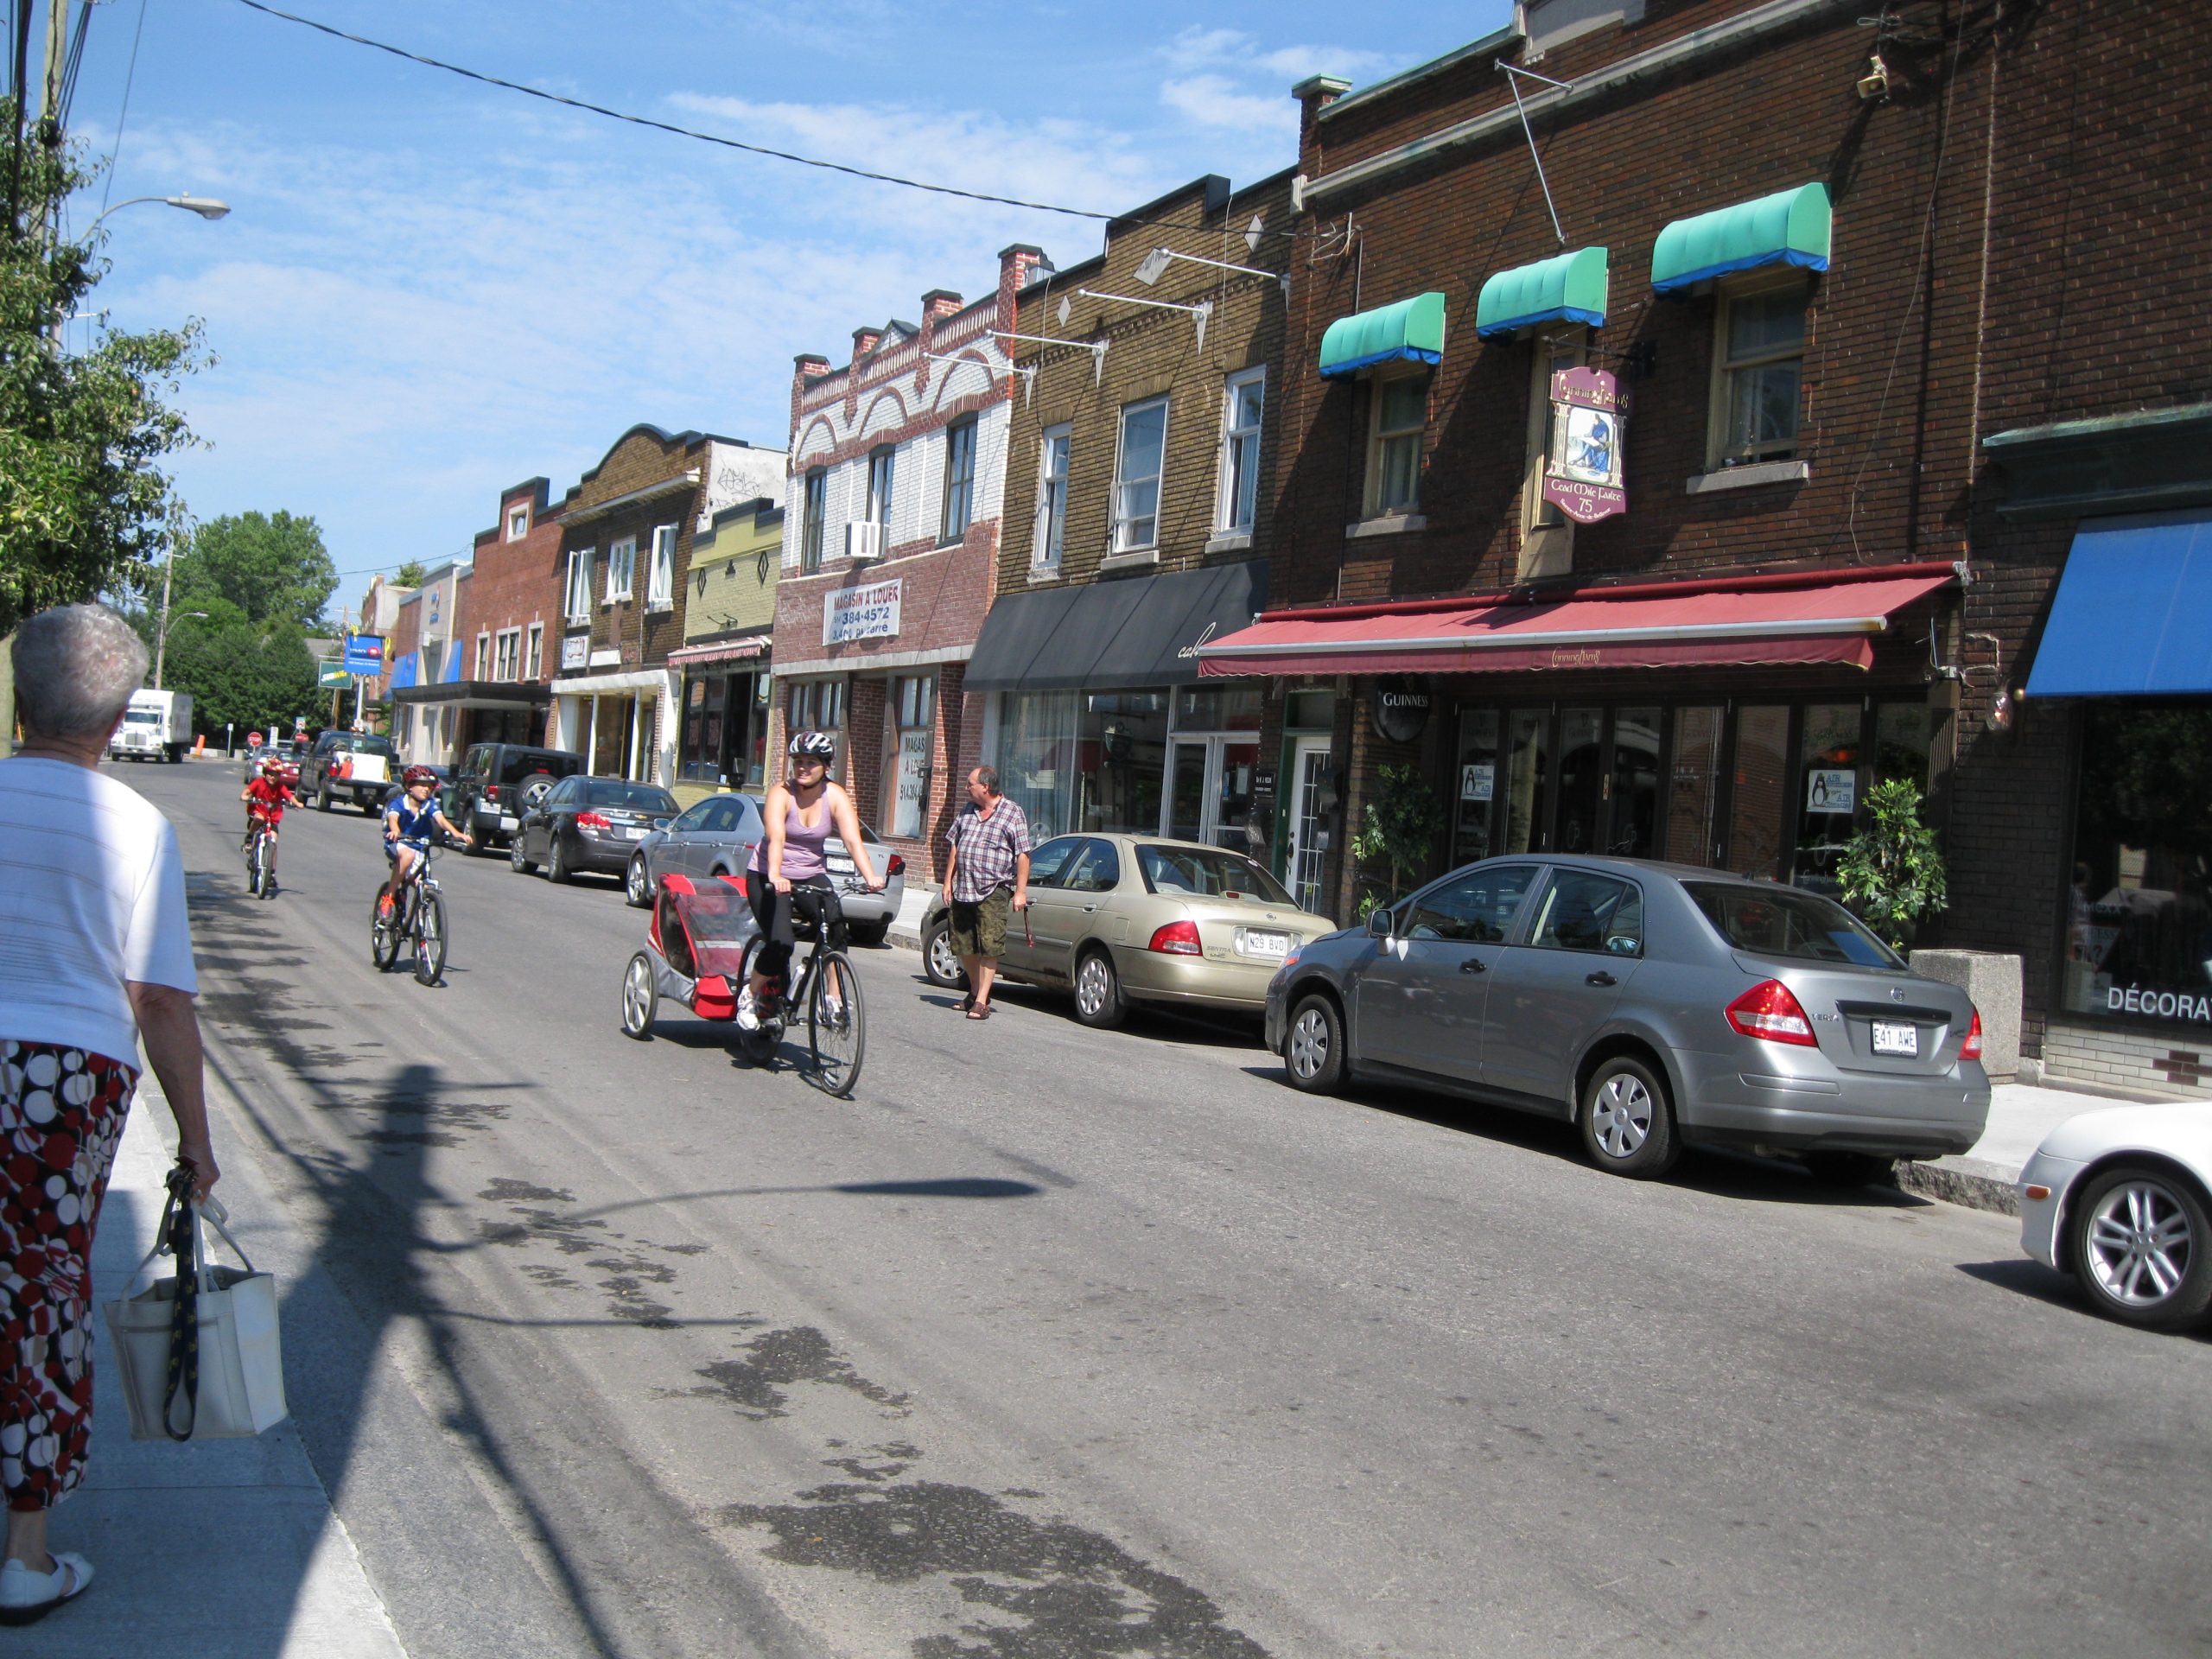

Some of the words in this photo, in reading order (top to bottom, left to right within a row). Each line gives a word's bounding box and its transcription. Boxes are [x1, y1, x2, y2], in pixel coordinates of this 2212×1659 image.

[1551, 479, 1573, 493] Cead
[1579, 498, 1592, 512] 75
[834, 591, 863, 611] MAGASIN
[865, 590, 870, 606] A
[873, 585, 899, 605] LOUER
[1382, 692, 1428, 707] GUINNESS
[1874, 1028, 1892, 1046] E41
[1898, 1030, 1916, 1048] AWE
